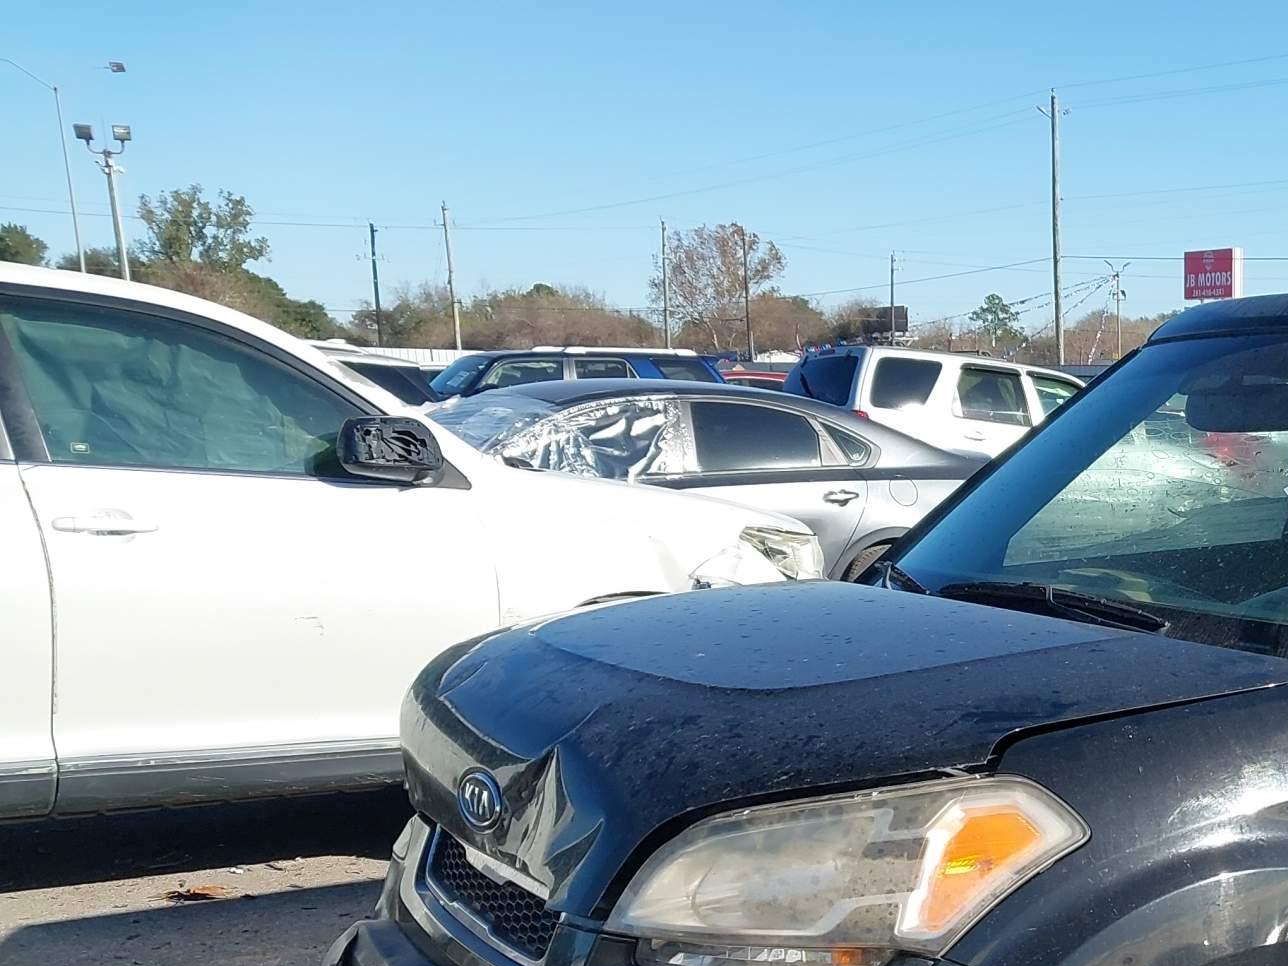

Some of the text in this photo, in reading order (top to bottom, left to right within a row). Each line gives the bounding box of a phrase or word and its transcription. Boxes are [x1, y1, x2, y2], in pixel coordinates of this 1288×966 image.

[1186, 271, 1232, 288] JB MOTORS
[465, 783, 490, 819] KIA
